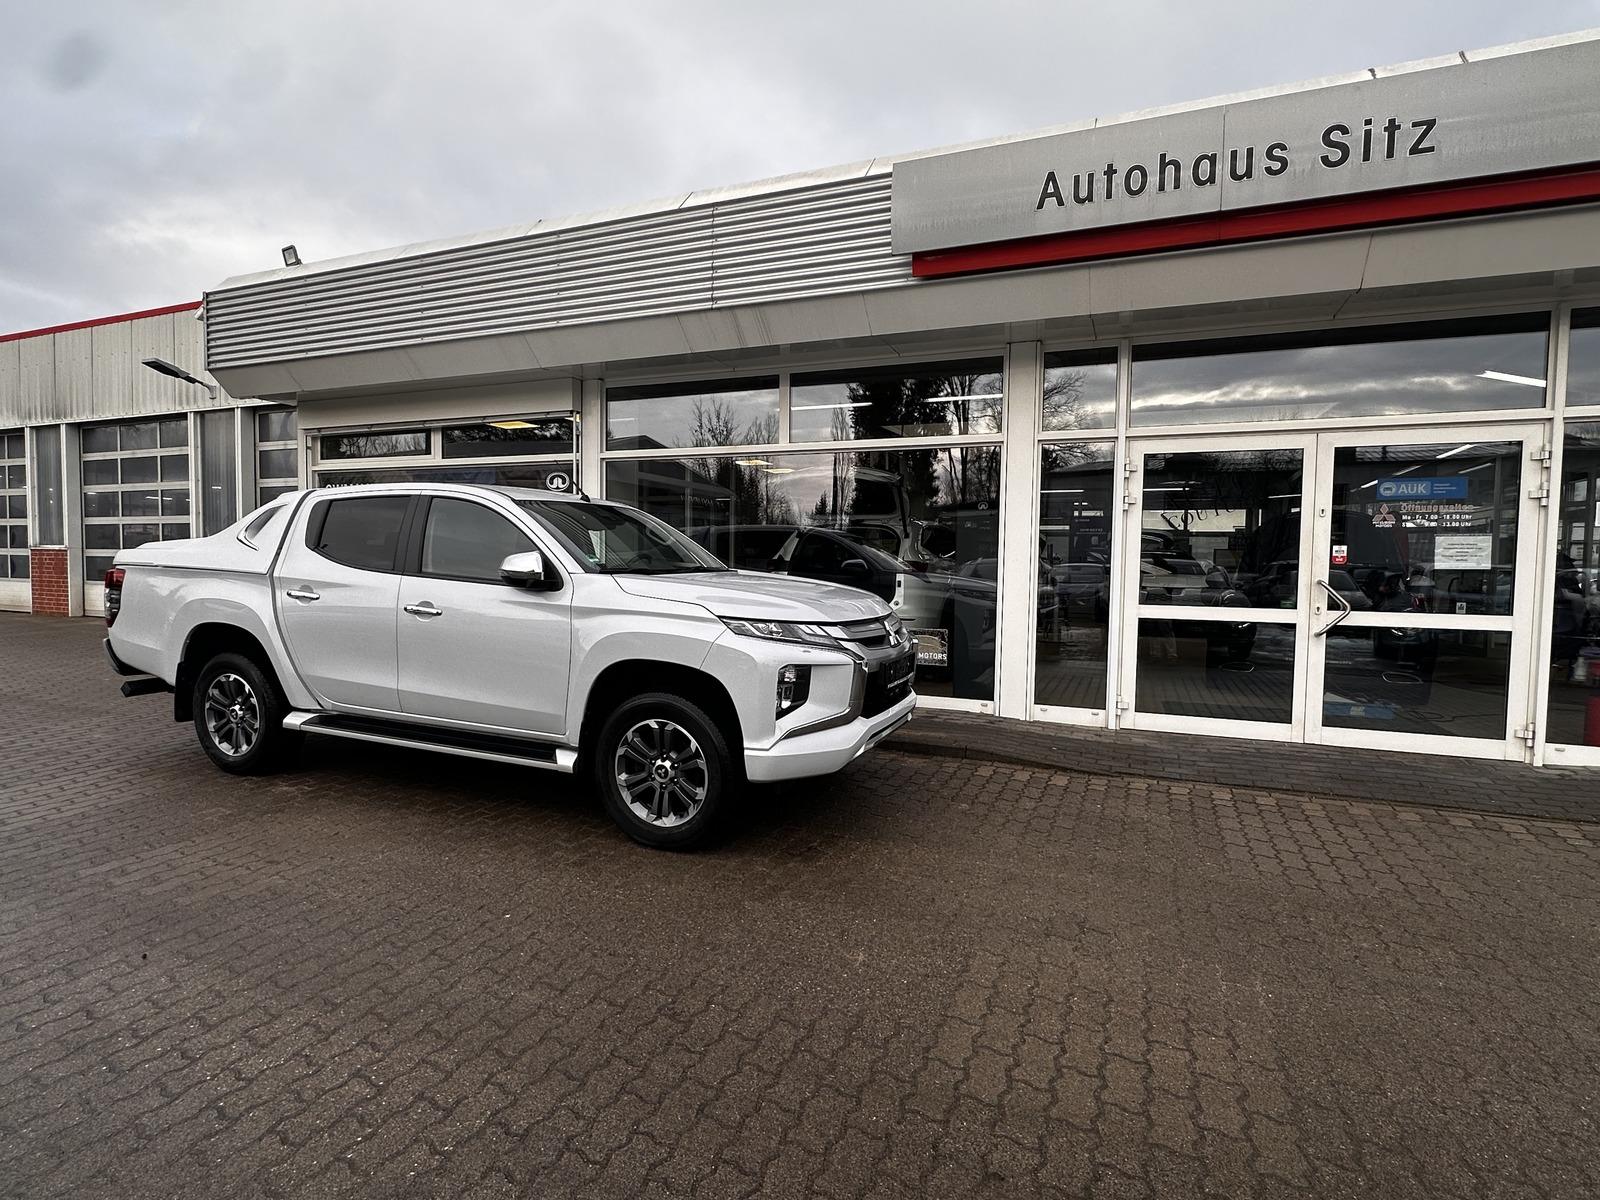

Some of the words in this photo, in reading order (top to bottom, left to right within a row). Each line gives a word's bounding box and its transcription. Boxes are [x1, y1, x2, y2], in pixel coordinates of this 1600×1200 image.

[1035, 141, 1290, 212] Autohaus
[1319, 117, 1438, 169] Sitz
[1398, 482, 1427, 495] AUK
[917, 652, 948, 660] MOTORS
